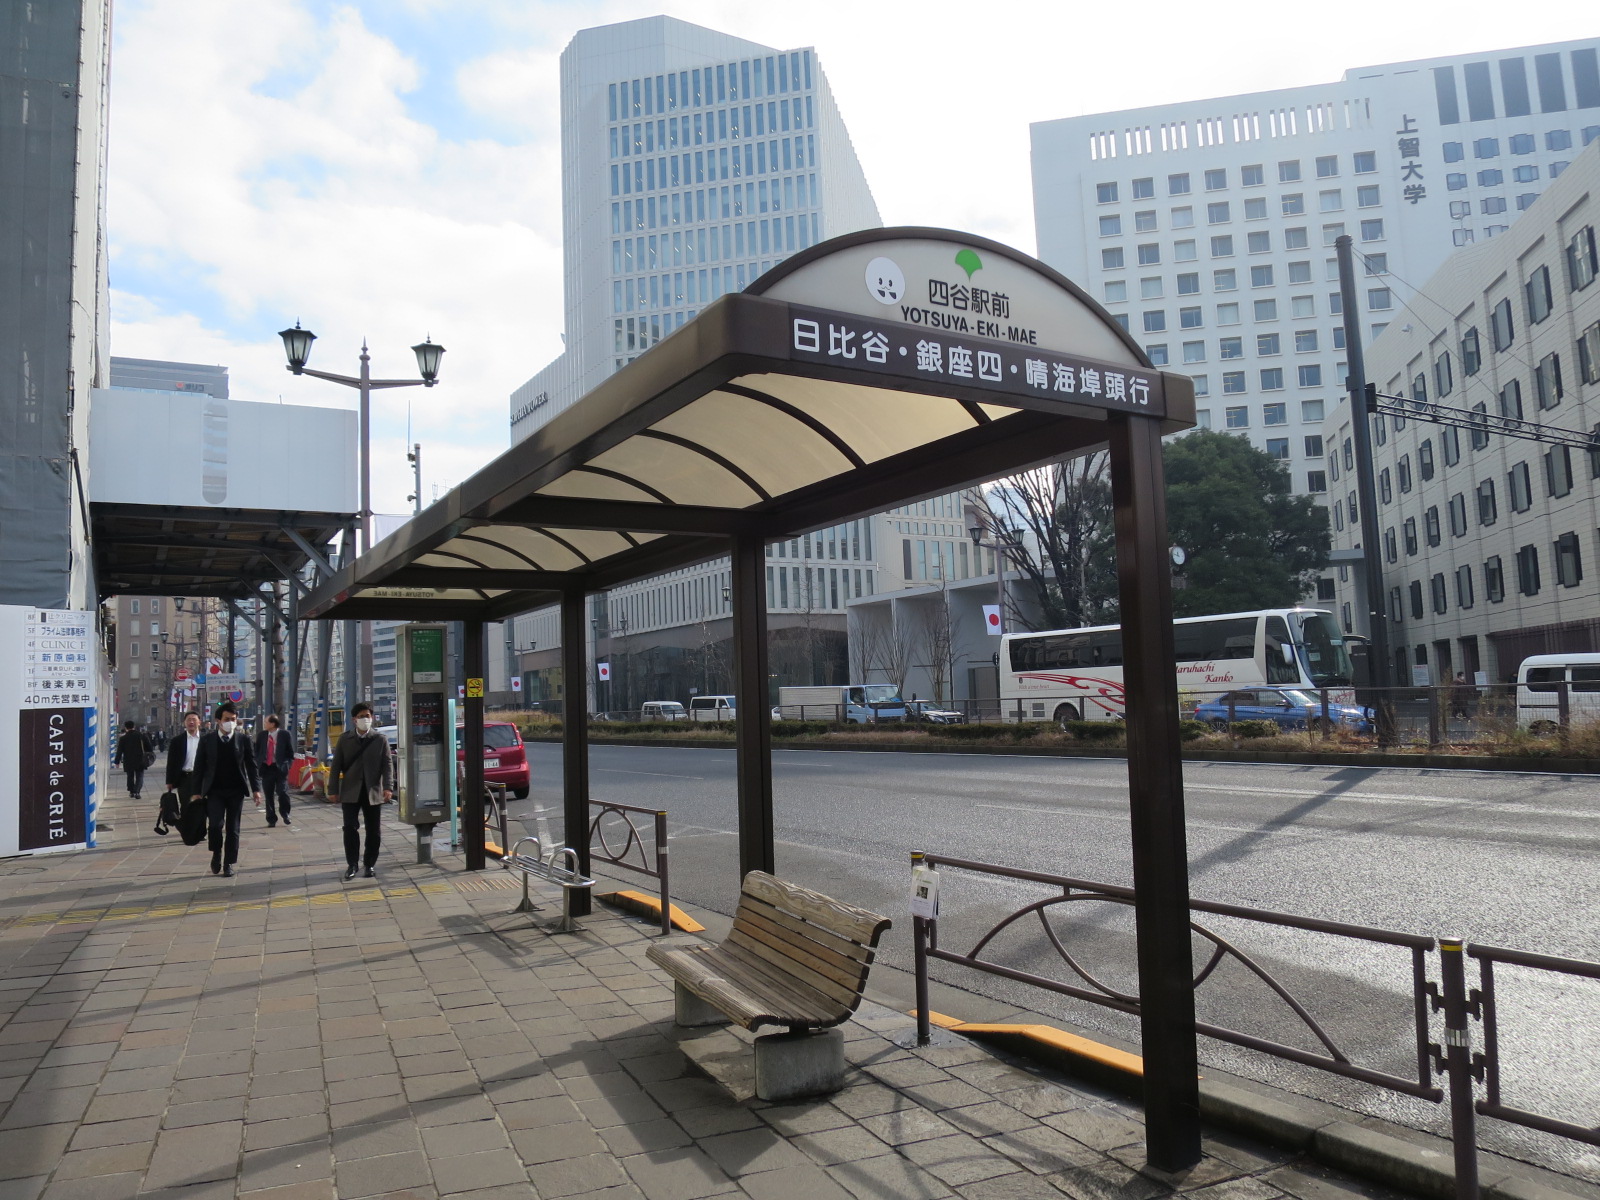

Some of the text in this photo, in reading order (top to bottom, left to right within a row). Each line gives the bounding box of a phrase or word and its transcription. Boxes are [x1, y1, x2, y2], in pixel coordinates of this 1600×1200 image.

[1396, 114, 1427, 205] 上智大学
[929, 279, 1010, 319] 四谷駅前
[793, 318, 1150, 405] 日比谷・銀座四・晴海埠頭行
[41, 641, 77, 649] CLINIC
[80, 641, 86, 649] F
[42, 653, 86, 662] 新原歯科
[1205, 671, 1234, 683] Kanko
[42, 680, 86, 688] 後楽寿司
[24, 694, 90, 704] 40m先営業中
[49, 714, 67, 840] CAFÉ de CRIÉ
